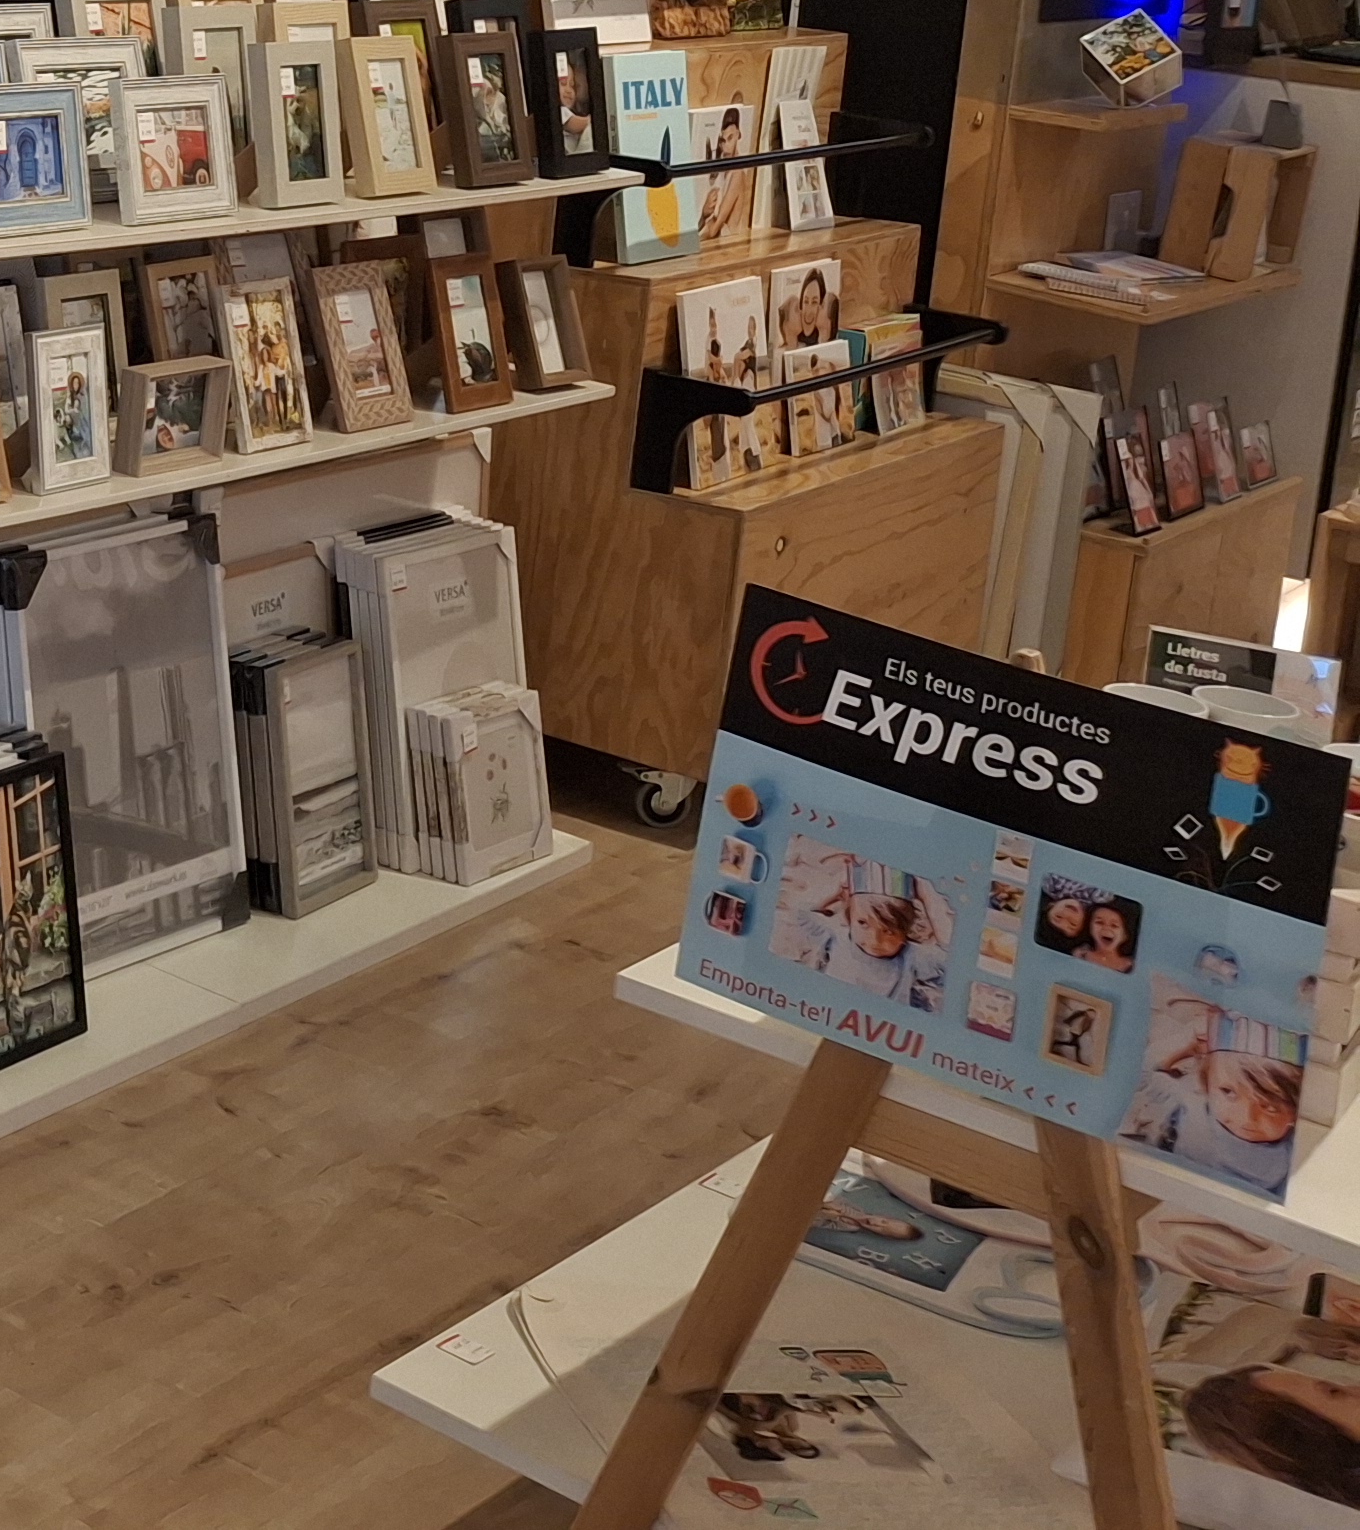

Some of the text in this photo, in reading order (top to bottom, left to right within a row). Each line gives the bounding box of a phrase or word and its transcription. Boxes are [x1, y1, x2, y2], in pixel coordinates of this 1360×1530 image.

[622, 77, 684, 111] ITALY
[251, 596, 283, 618] VERSA
[434, 585, 466, 603] VERSA
[1166, 641, 1220, 663] Lletres
[1164, 660, 1184, 675] de
[1186, 664, 1227, 683] fusta
[883, 656, 1111, 746] Els teus productes
[821, 669, 1107, 807] Express
[698, 958, 1015, 1095] Emporta-te'l AVUI mateix
